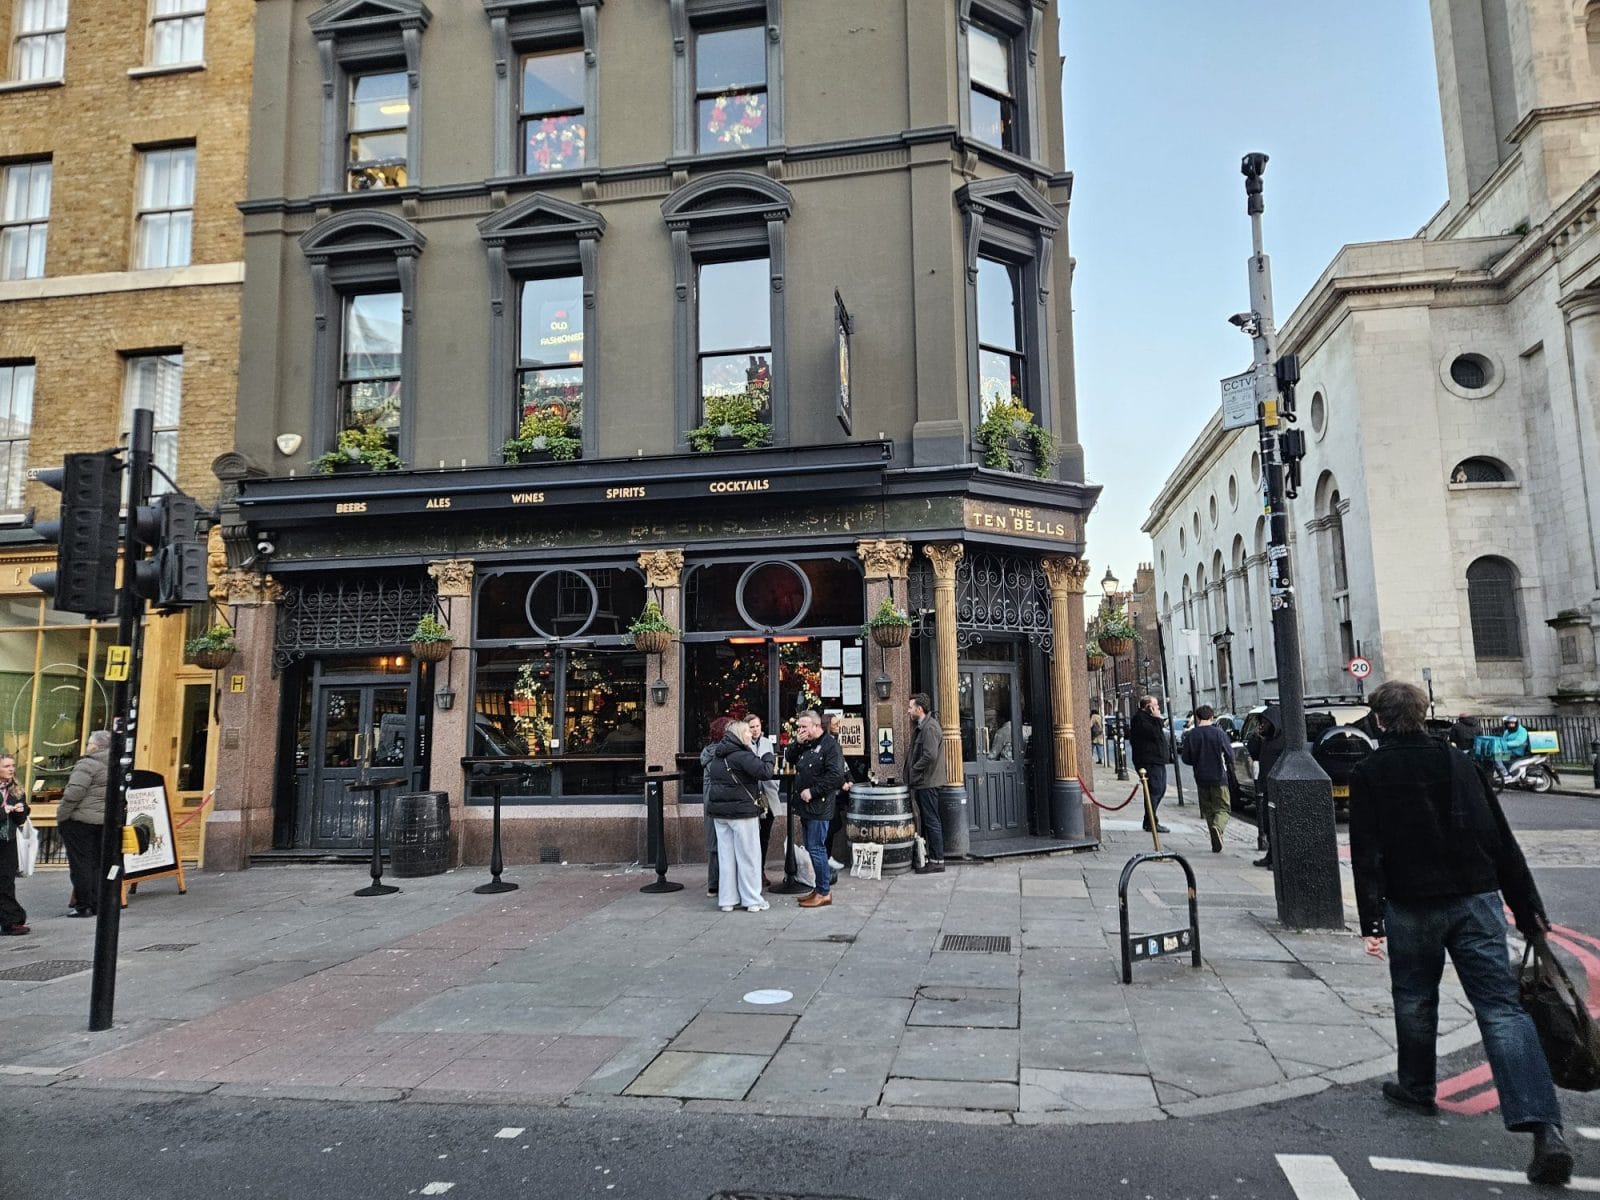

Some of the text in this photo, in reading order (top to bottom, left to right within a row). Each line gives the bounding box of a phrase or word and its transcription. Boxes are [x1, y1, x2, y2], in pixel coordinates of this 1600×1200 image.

[551, 321, 568, 330] OLD
[1223, 377, 1252, 392] CCTV
[335, 479, 770, 514] BEERS ALES WINES SPIRITS COCKTAILS
[1008, 507, 1032, 519] THE
[973, 512, 1065, 536] TEN BELLS
[109, 650, 126, 677] H
[1352, 663, 1368, 672] 20
[233, 677, 243, 691] H
[840, 735, 861, 745] RADE
